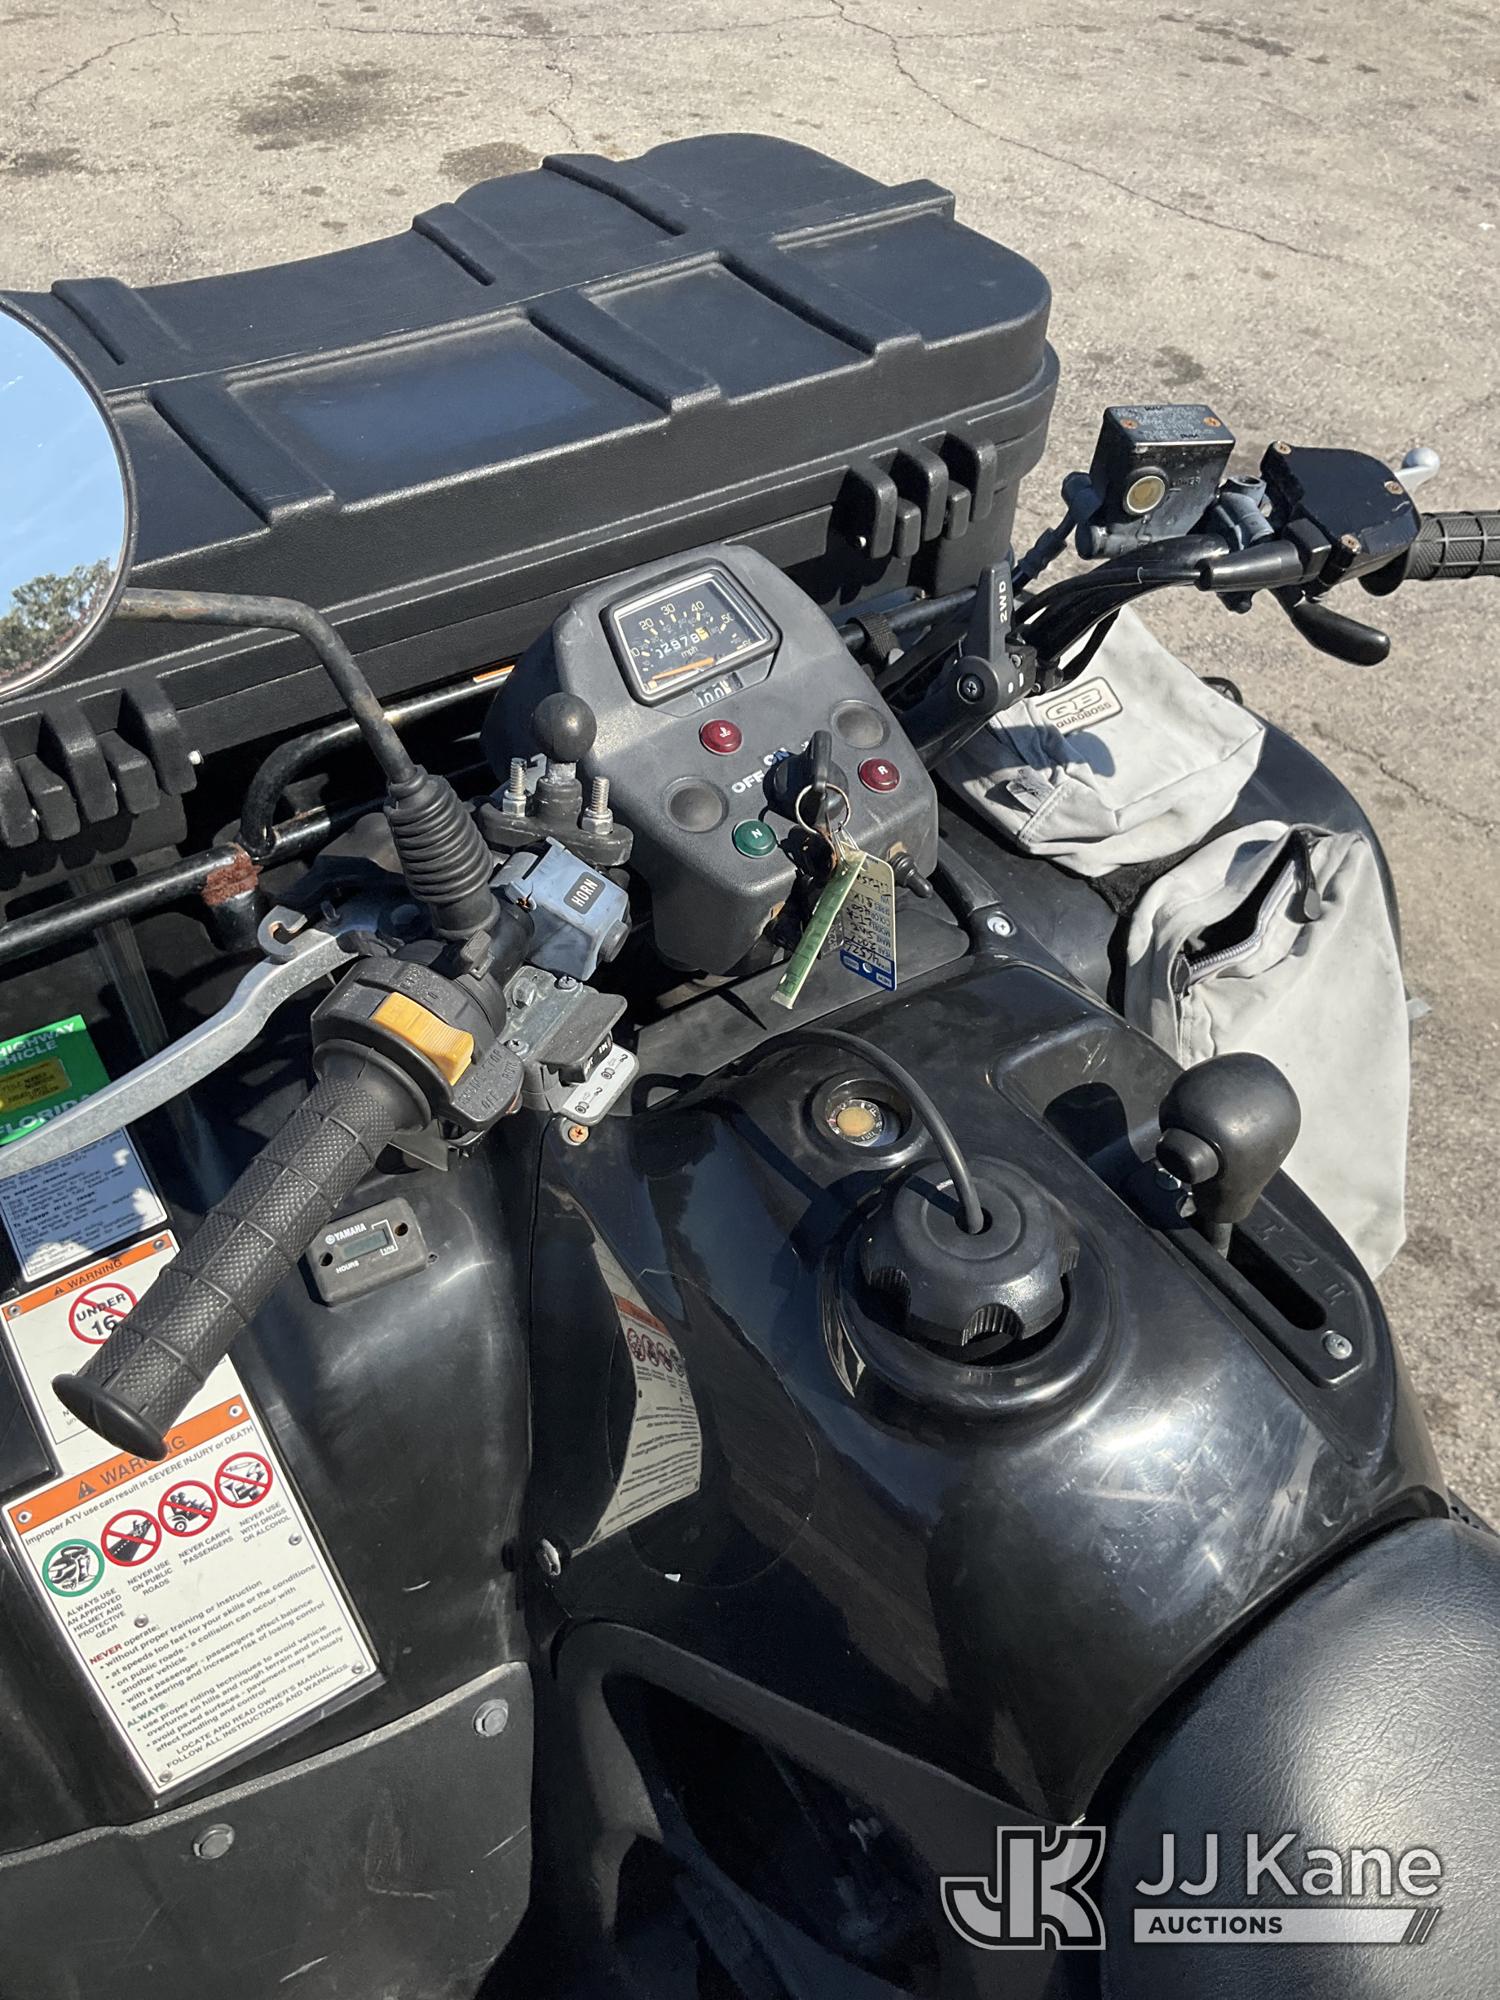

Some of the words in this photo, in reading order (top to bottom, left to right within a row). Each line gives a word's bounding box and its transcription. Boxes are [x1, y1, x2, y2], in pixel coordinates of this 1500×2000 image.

[661, 603, 675, 615] 30
[691, 600, 704, 612] 40
[999, 580, 1008, 623] 2WD
[639, 618, 654, 630] 20
[721, 612, 735, 624] 50
[681, 646, 698, 658] mph
[1046, 688, 1102, 720] QB
[1056, 702, 1112, 729] QUADBOSS
[764, 747, 790, 766] ON
[877, 765, 888, 775] R
[732, 770, 766, 794] OFF
[751, 829, 763, 840] N
[571, 878, 598, 907] HORN
[598, 1042, 608, 1054] IN
[334, 1223, 366, 1240] YAMAHA
[68, 1258, 122, 1290] WARNING
[336, 1260, 360, 1274] HOURS
[76, 1293, 126, 1322] UNDER
[92, 1314, 118, 1336] 16
[25, 1522, 63, 1546] Improper
[65, 1511, 82, 1526] ATV
[82, 1505, 99, 1516] use
[99, 1497, 115, 1509] can
[115, 1484, 140, 1501] result
[139, 1480, 148, 1488] in
[148, 1461, 183, 1483] SEVERE
[183, 1445, 213, 1466] INJURY
[215, 1441, 224, 1449] or
[224, 1426, 253, 1445] DEATH
[239, 1510, 264, 1527] NEVER
[265, 1501, 281, 1513] USE
[239, 1521, 260, 1535] WITH
[260, 1507, 287, 1525] DRUGS
[178, 1542, 204, 1559] NEVER
[204, 1527, 230, 1545] CARRY
[242, 1533, 255, 1543] OR
[256, 1515, 291, 1536] ALCOHOL
[183, 1536, 234, 1565] PASSENGERS
[127, 1568, 153, 1585] NEVER
[154, 1559, 170, 1571] USE
[131, 1582, 144, 1592] ON
[144, 1567, 173, 1585] PUBLIC
[142, 1578, 170, 1596] ROADS
[67, 1597, 99, 1618] ALWAYS
[99, 1587, 116, 1599] USE
[67, 1616, 79, 1626] AN
[80, 1594, 122, 1619] APPROVED
[73, 1612, 104, 1632] HELMET
[106, 1603, 123, 1615] AND
[77, 1610, 126, 1639] PROTECTIVE
[95, 1623, 118, 1638] GEAR
[105, 1645, 139, 1667] without
[140, 1630, 168, 1650] proper
[170, 1611, 204, 1632] training
[205, 1605, 215, 1614] or
[216, 1580, 262, 1608] instruction
[111, 1668, 121, 1678] at
[121, 1652, 153, 1671] speeds
[153, 1643, 169, 1654] too
[169, 1632, 188, 1645] fast
[188, 1625, 200, 1636] for
[201, 1614, 221, 1629] your
[222, 1602, 245, 1617] skills
[246, 1596, 256, 1604] or
[256, 1588, 271, 1599] the
[272, 1564, 316, 1590] conditions
[116, 1677, 129, 1687] on
[130, 1662, 157, 1681] public
[158, 1648, 184, 1664] roads
[197, 1620, 234, 1643] collision
[235, 1611, 251, 1623] can
[252, 1597, 276, 1613] occur
[277, 1586, 296, 1599] with
[126, 1690, 146, 1703] with
[154, 1661, 198, 1690] passenger
[205, 1631, 254, 1662] passengers
[255, 1616, 280, 1633] affect
[280, 1599, 313, 1619] balance
[89, 1643, 122, 1665] NEVER
[131, 1698, 148, 1711] and
[149, 1679, 185, 1701] steering
[185, 1668, 203, 1682] and
[202, 1649, 239, 1671] increase
[240, 1639, 257, 1651] risk
[258, 1632, 267, 1641] of
[268, 1619, 295, 1636] losing
[295, 1600, 325, 1621] control
[121, 1673, 154, 1695] another
[156, 1656, 187, 1675] vehicle
[142, 1718, 159, 1730] use
[160, 1701, 188, 1721] proper
[190, 1687, 216, 1704] riding
[215, 1661, 262, 1689] techniques
[262, 1655, 273, 1663] to
[273, 1641, 297, 1657] avoid
[297, 1625, 327, 1643] vehicle
[147, 1712, 188, 1737] overturns
[189, 1704, 201, 1714] on
[201, 1694, 221, 1706] hills
[222, 1682, 238, 1696] and
[239, 1669, 264, 1686] rough
[264, 1654, 293, 1671] terrain
[294, 1643, 310, 1656] and
[320, 1626, 342, 1641] turns
[151, 1728, 176, 1745] avoid
[177, 1713, 203, 1732] paved
[204, 1694, 240, 1716] surfaces
[246, 1667, 286, 1693] pavement
[287, 1657, 305, 1670] may
[306, 1635, 343, 1659] seriously
[156, 1735, 180, 1752] affect
[181, 1715, 219, 1738] handling
[219, 1704, 236, 1717] and
[237, 1687, 266, 1707] control
[166, 1745, 203, 1768] FOLLOW
[205, 1736, 222, 1748] ALL
[222, 1701, 284, 1738] INSTRUCTIONS
[285, 1689, 303, 1703] AND
[176, 1732, 211, 1755] LOCATE
[213, 1721, 231, 1735] AND
[232, 1707, 256, 1724] READ
[257, 1685, 296, 1709] OWNER'S
